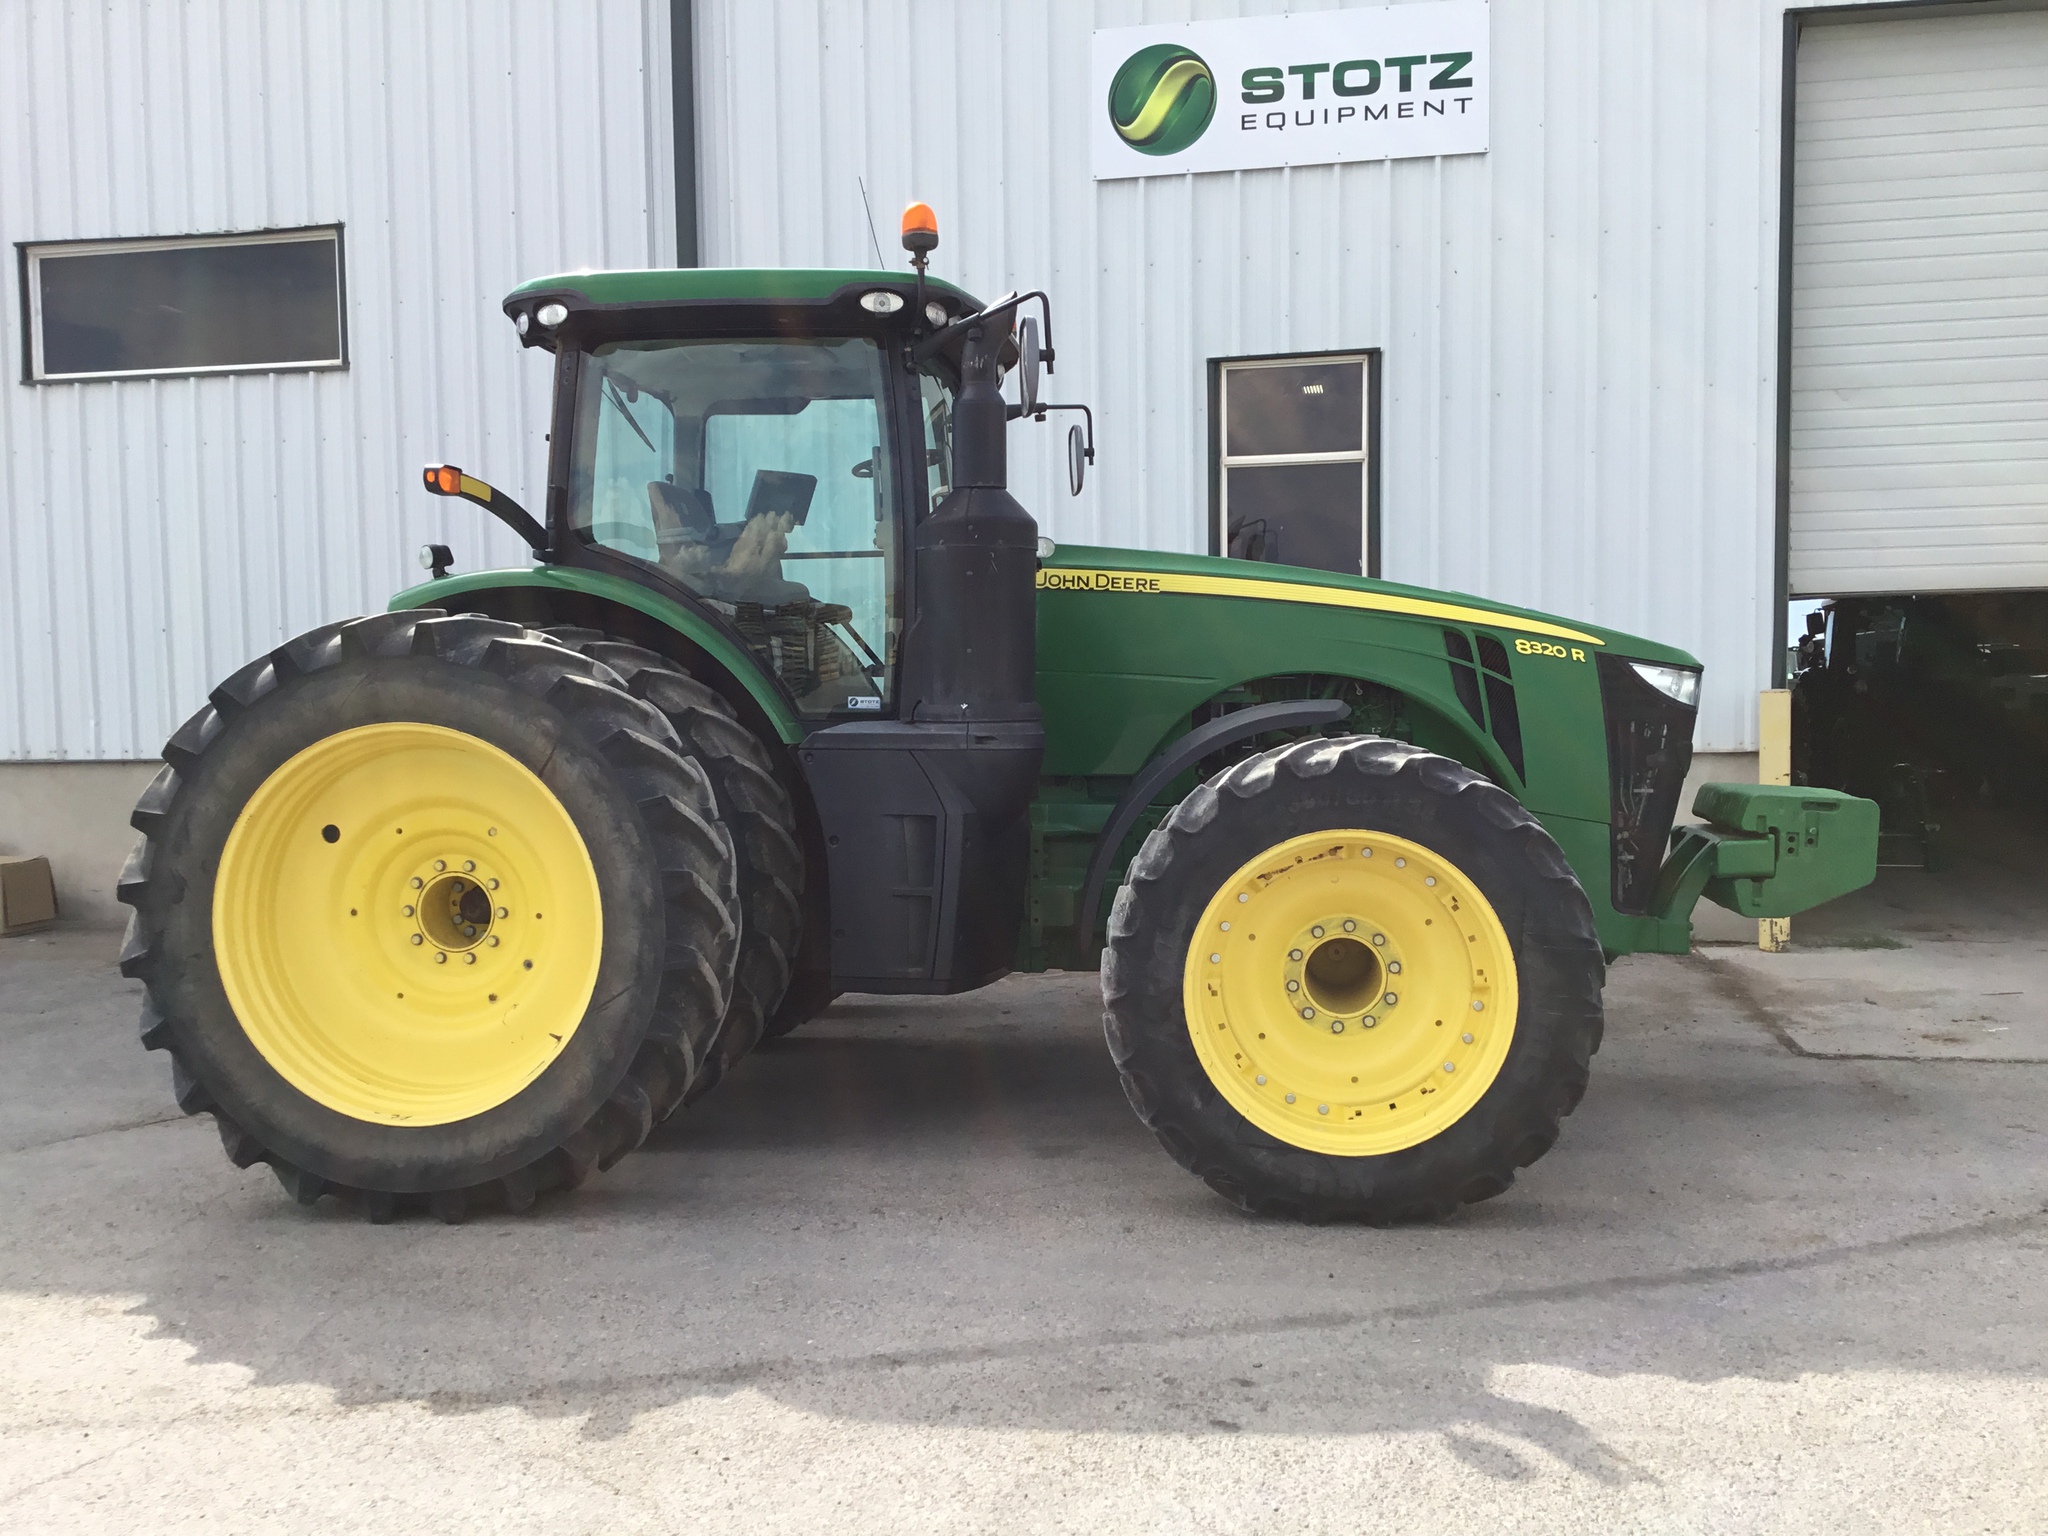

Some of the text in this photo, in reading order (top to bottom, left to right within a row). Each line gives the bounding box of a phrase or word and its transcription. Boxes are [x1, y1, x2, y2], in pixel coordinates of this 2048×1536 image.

[1241, 51, 1473, 104] STOTZ
[1241, 97, 1473, 131] EQUIPMENT
[1037, 572, 1160, 591] JOHN DEERE
[1514, 638, 1587, 663] 8320 R
